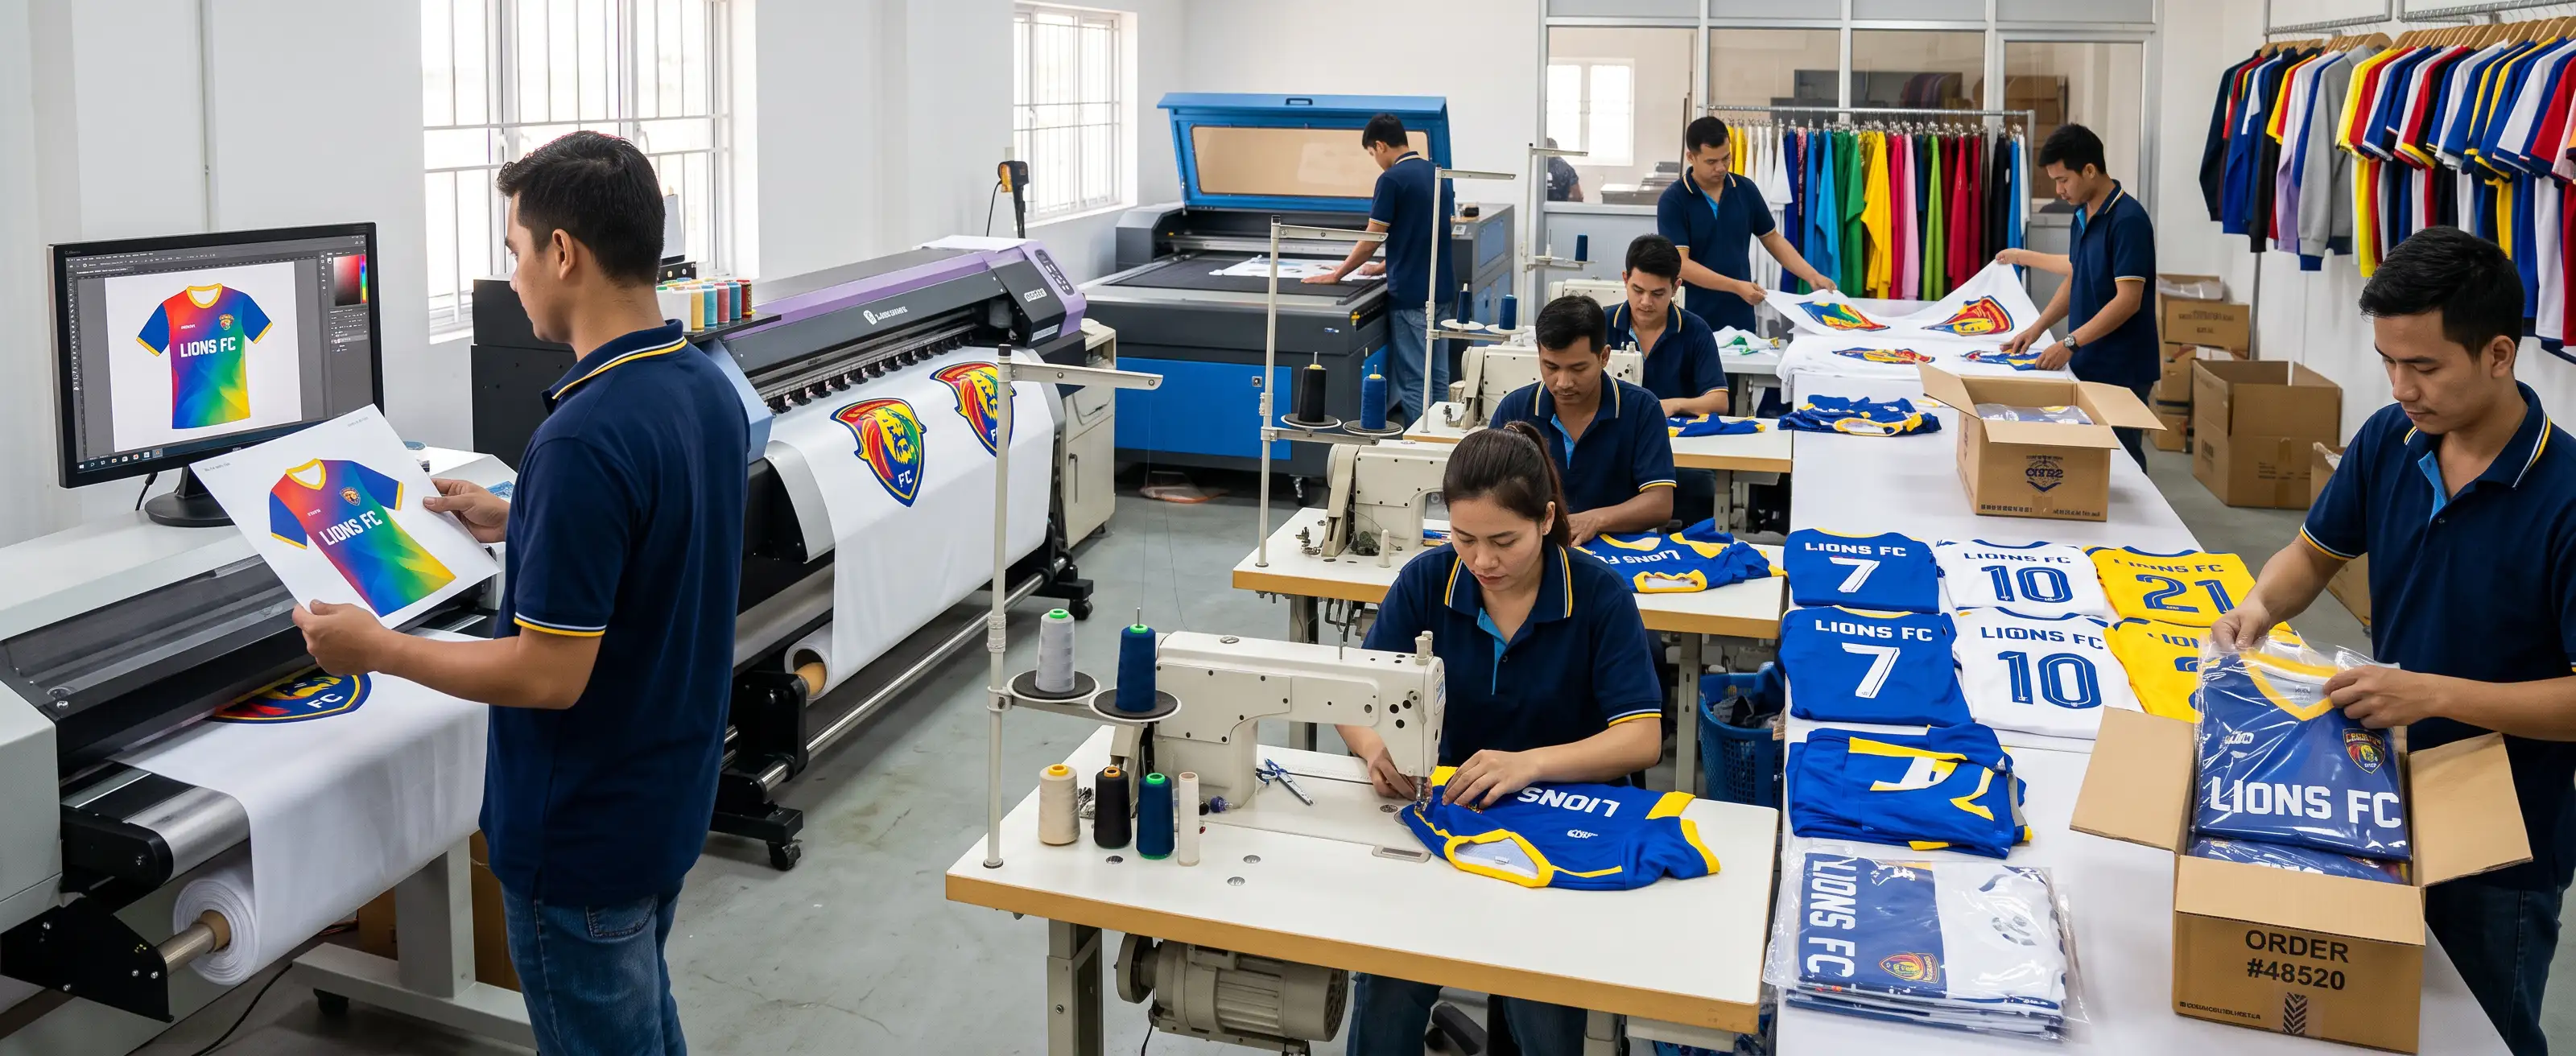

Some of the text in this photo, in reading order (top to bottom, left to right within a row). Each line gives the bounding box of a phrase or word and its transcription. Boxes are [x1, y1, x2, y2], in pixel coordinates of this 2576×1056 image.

[180, 336, 237, 358] LIONS FC
[898, 470, 913, 488] FC
[318, 510, 383, 546] LIONS FC
[1622, 550, 1682, 563] LIONS
[1805, 542, 1907, 557] LIONS FC
[1829, 556, 1880, 593] 7
[1981, 565, 2074, 604] 10
[2194, 564, 2224, 573] FC
[2135, 574, 2235, 615] 21
[1815, 619, 1933, 641] LIONS FC
[2073, 633, 2103, 650] FC
[1841, 642, 1901, 699] 7
[1997, 650, 2103, 709] 10
[306, 693, 344, 709] FC
[1517, 786, 1620, 818] LIONS
[2210, 776, 2402, 828] LIONS FC
[1806, 860, 1857, 978] LIONS FC
[2245, 930, 2349, 963] ORDER
[2247, 958, 2346, 991] #48520
